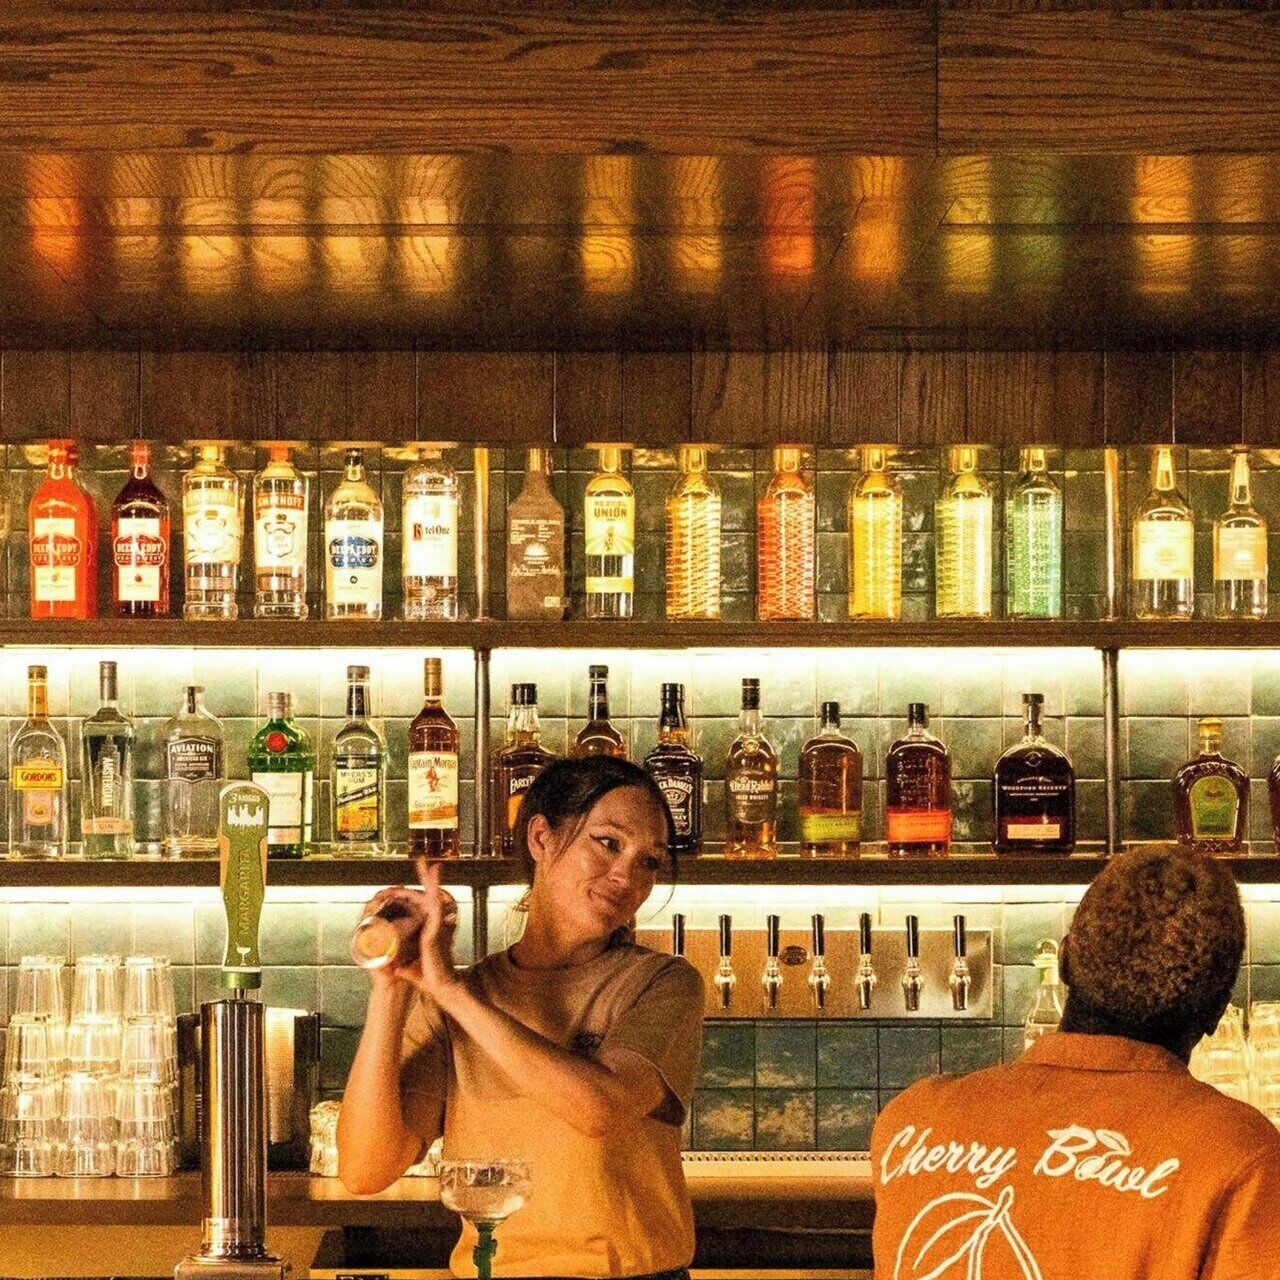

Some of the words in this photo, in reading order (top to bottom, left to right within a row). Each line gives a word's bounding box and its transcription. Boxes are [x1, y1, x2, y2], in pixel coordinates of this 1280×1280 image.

[594, 508, 627, 518] UNION
[171, 744, 214, 753] AVIATION
[880, 1125, 1017, 1189] Cherry
[1034, 1124, 1180, 1198] Bowl
